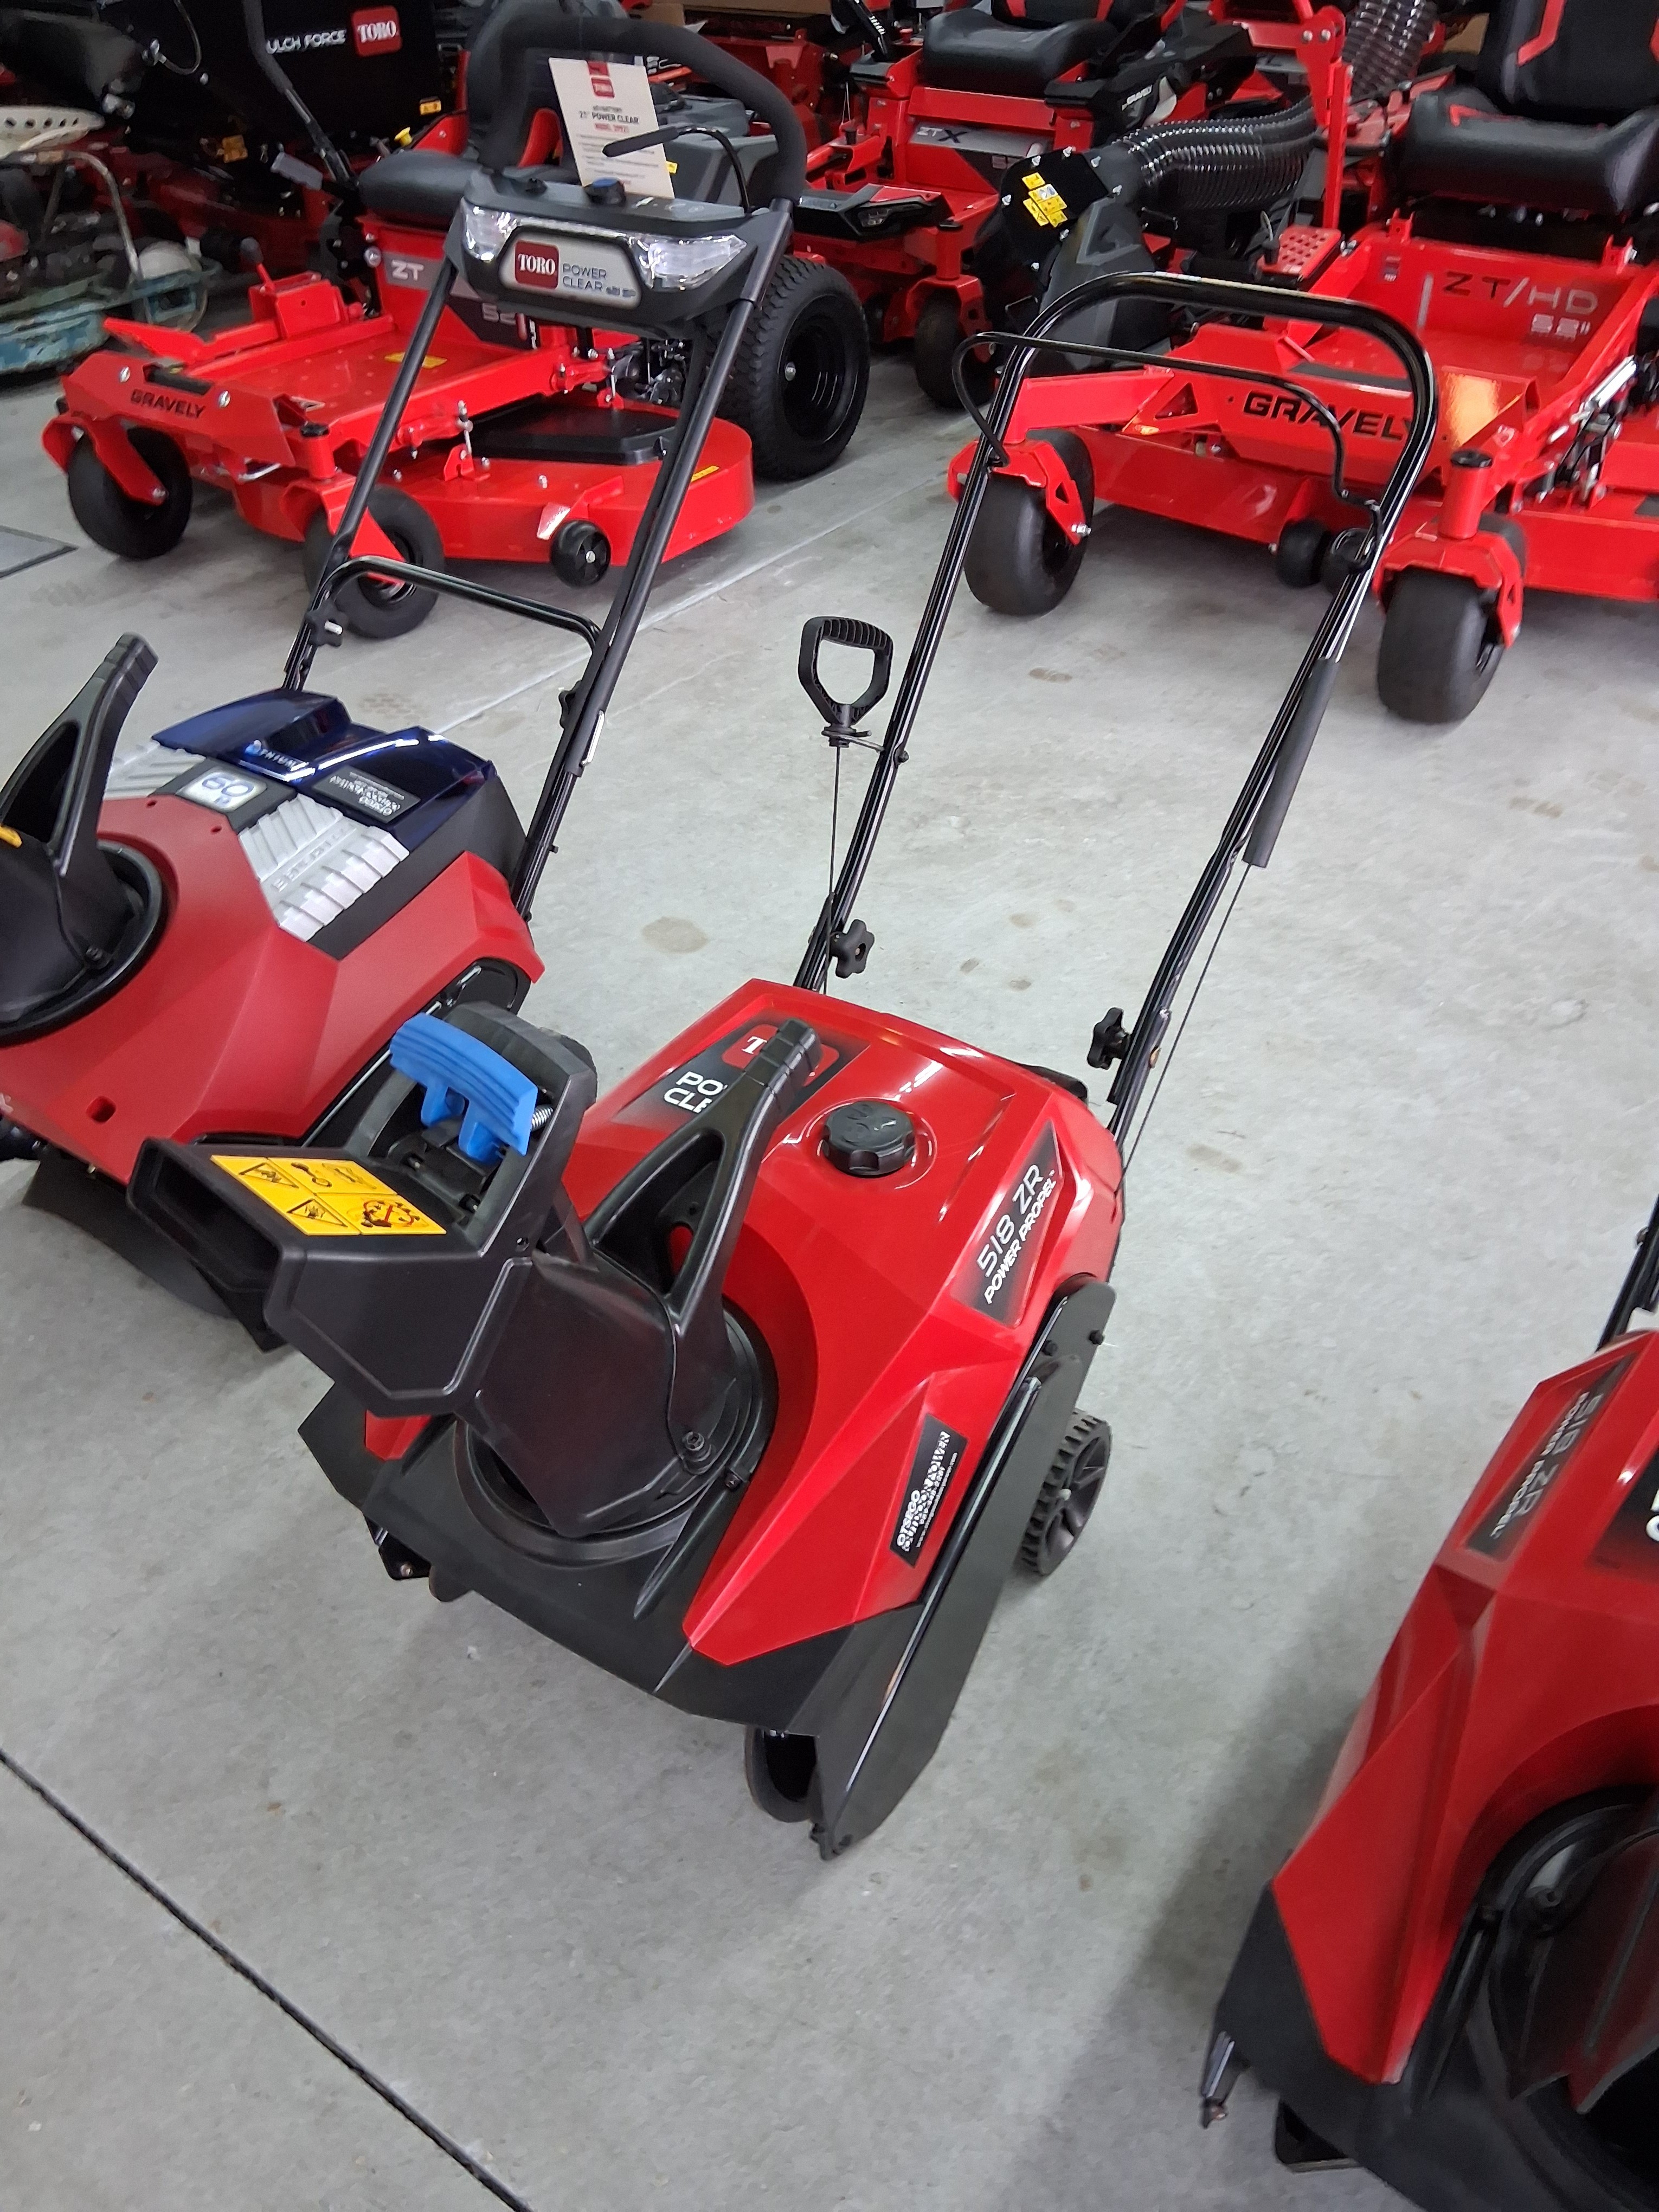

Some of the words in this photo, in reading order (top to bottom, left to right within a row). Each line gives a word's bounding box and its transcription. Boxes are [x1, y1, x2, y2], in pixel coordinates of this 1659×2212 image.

[266, 36, 301, 54] ULCH
[304, 29, 347, 52] FORCE
[358, 20, 397, 43] TORO
[391, 259, 424, 281] ZT
[517, 253, 556, 276] TORO
[563, 262, 607, 280] POWER
[563, 275, 603, 292] CLEAR
[131, 389, 205, 418] GRAVELY
[664, 1088, 713, 1113] CLE
[976, 1214, 1015, 1277] 518
[1012, 1165, 1044, 1215] ZR
[984, 1239, 1022, 1304] POWER
